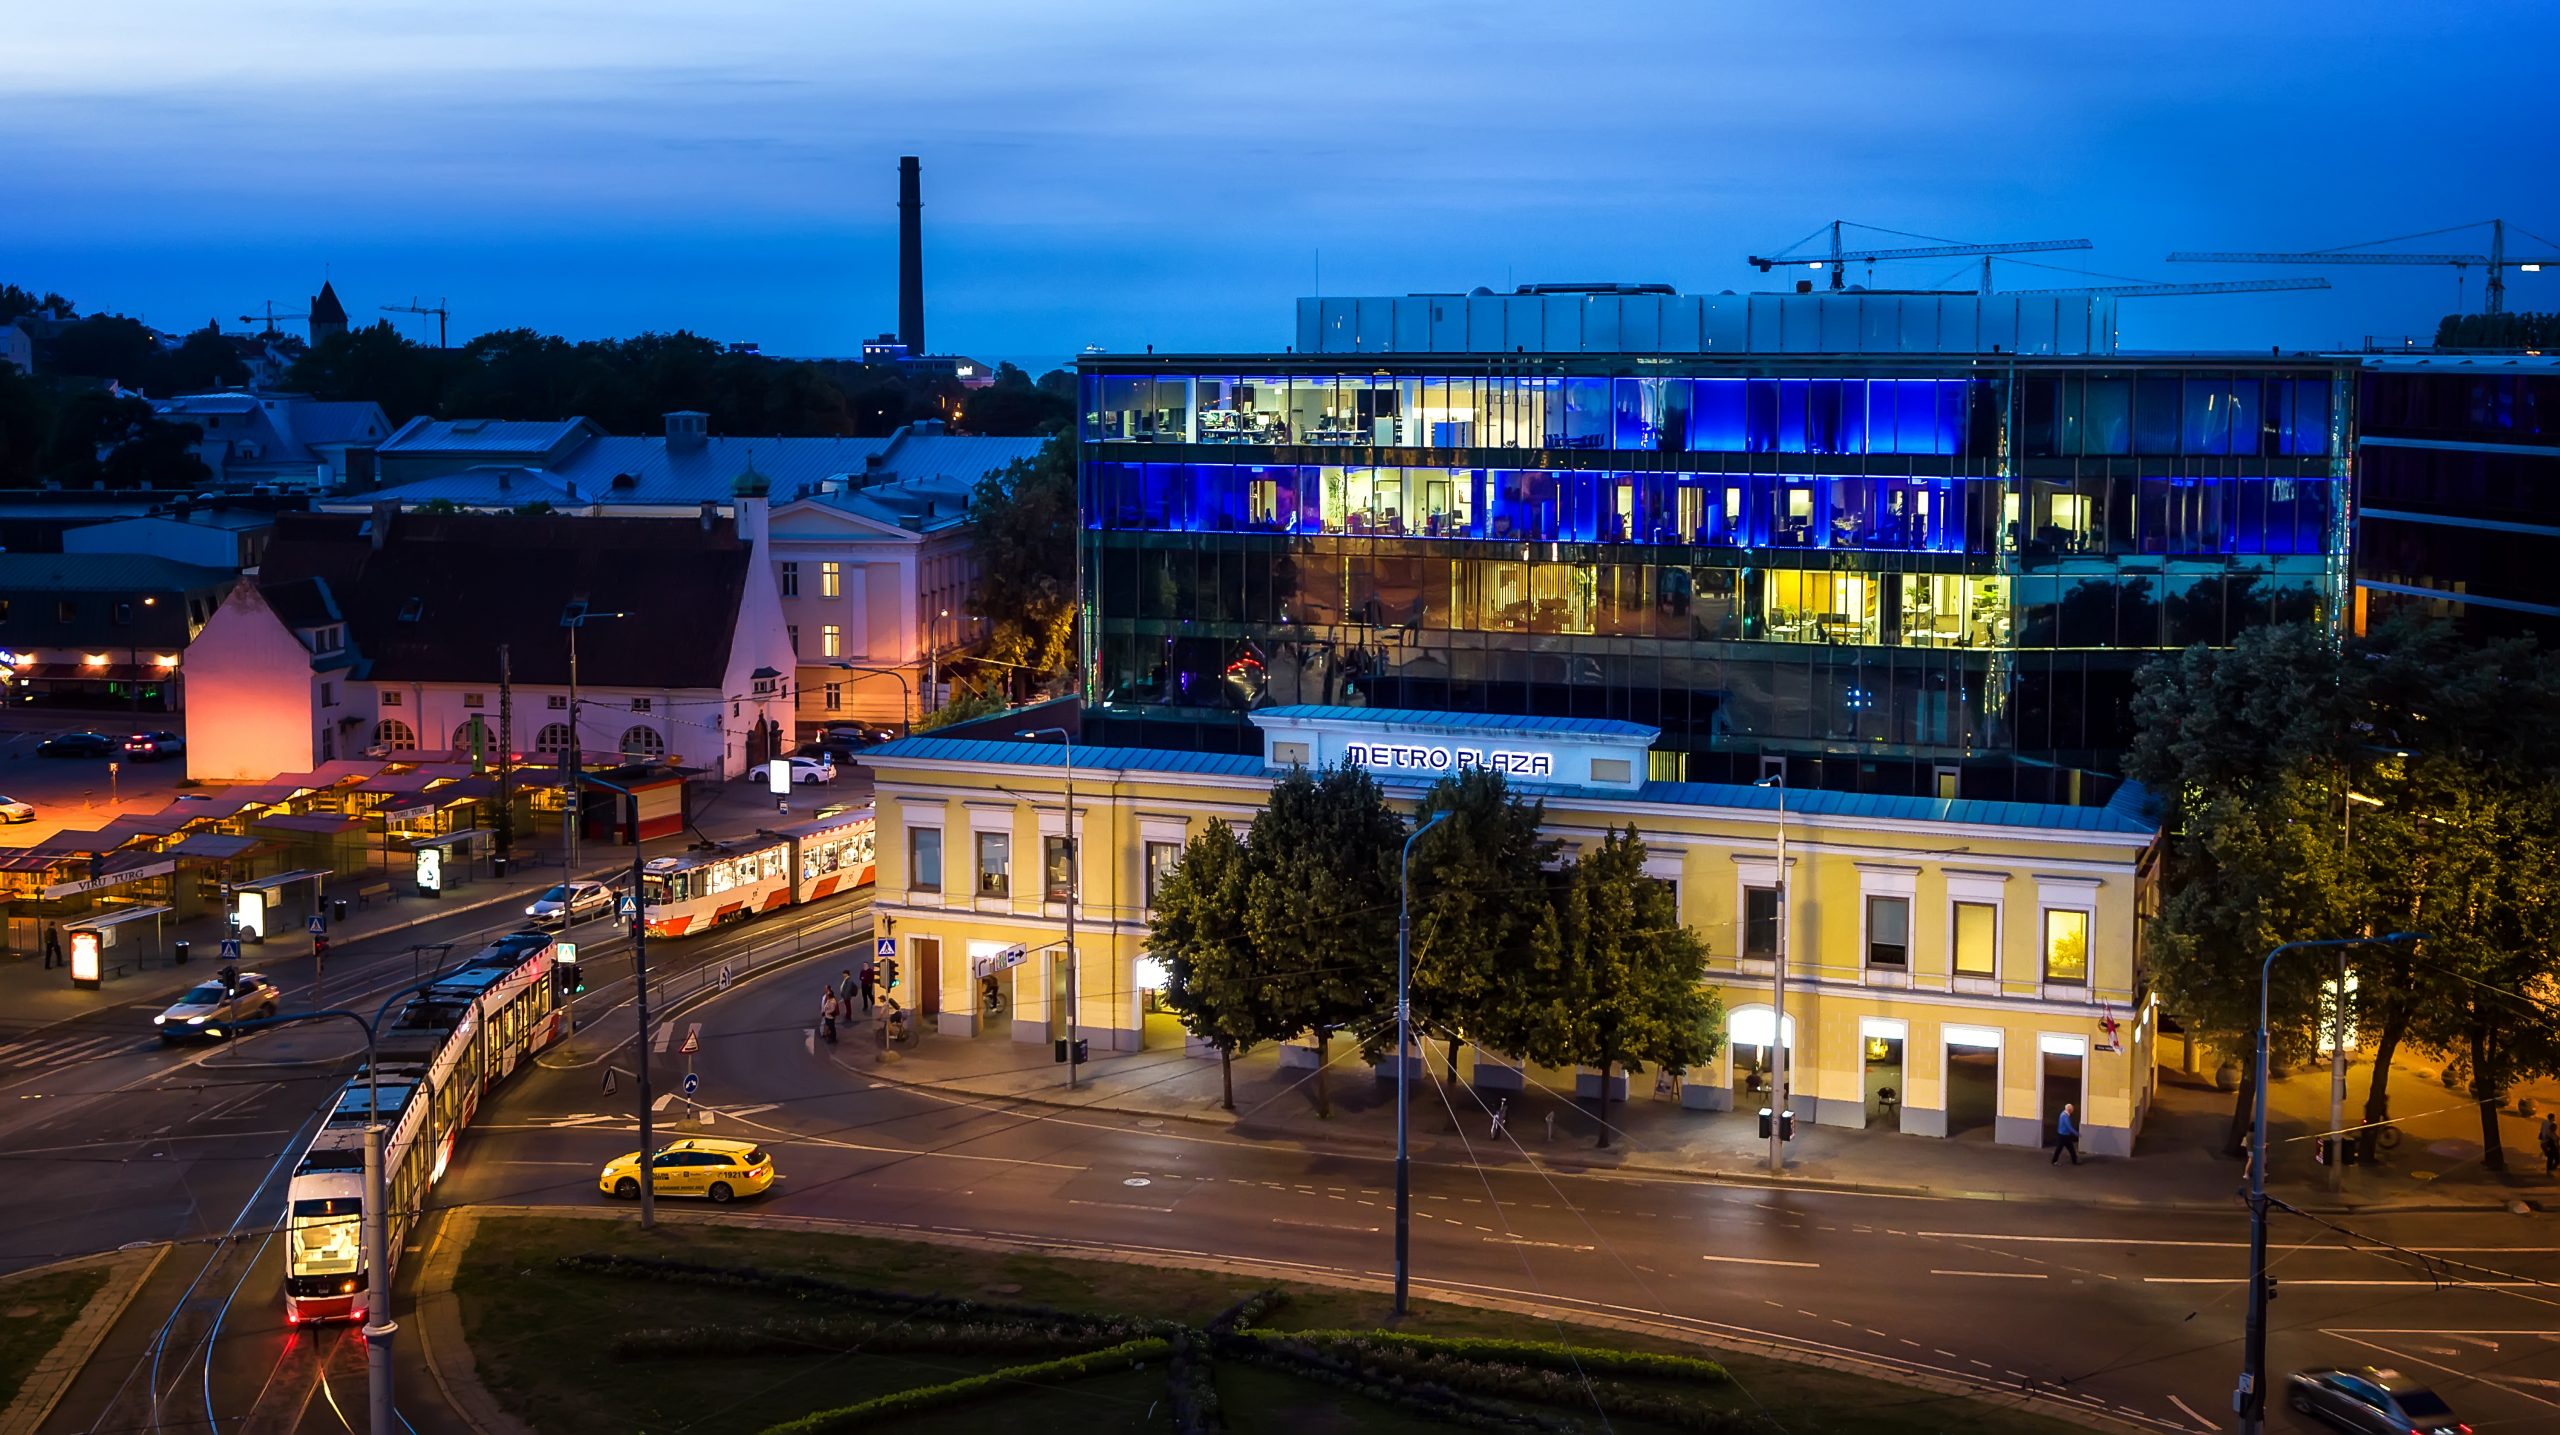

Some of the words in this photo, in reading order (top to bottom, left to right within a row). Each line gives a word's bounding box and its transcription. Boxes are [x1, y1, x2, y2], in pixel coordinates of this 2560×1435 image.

[1348, 745, 1448, 768] METRO
[1457, 751, 1550, 775] PLAZA
[78, 877, 106, 891] VIRU
[112, 869, 144, 883] TURG
[723, 1171, 741, 1179] 1921
[325, 1200, 334, 1214] 1
